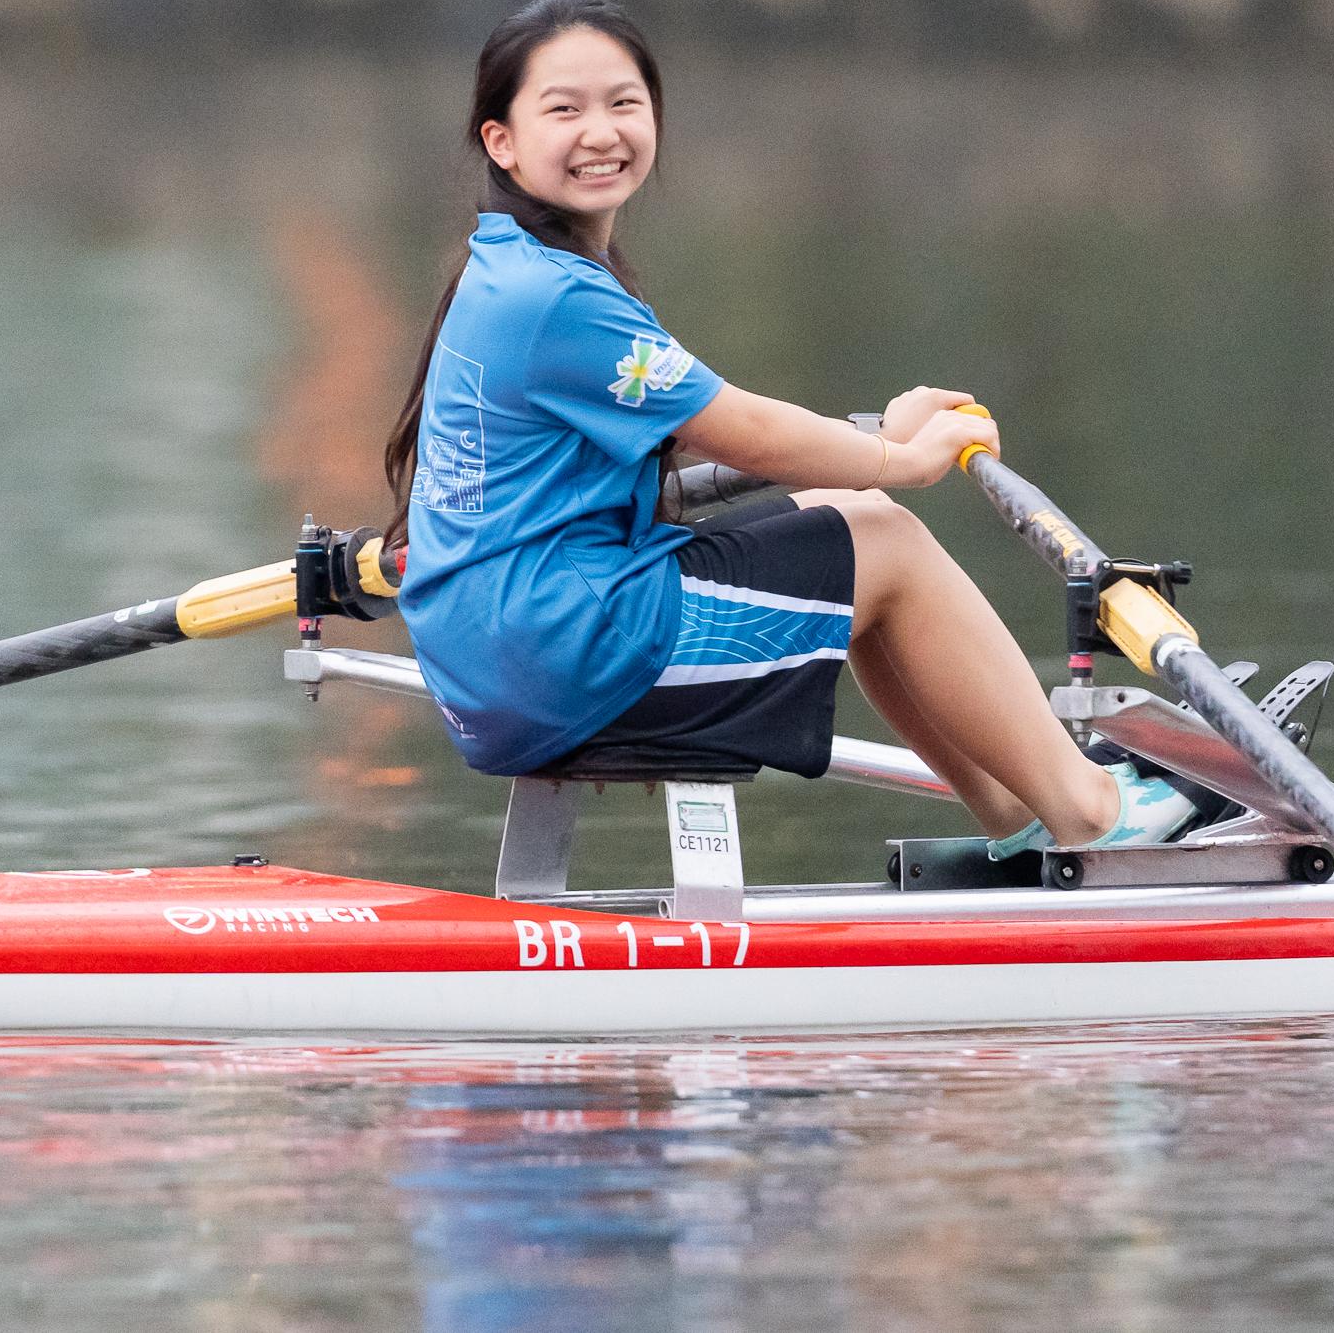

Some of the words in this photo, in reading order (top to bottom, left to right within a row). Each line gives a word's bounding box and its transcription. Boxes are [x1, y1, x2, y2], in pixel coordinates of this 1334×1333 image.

[678, 834, 729, 853] CE1121
[210, 906, 380, 923] WINTECH
[227, 922, 310, 933] RACING
[513, 919, 585, 967] BR
[616, 921, 750, 967] 1-17
